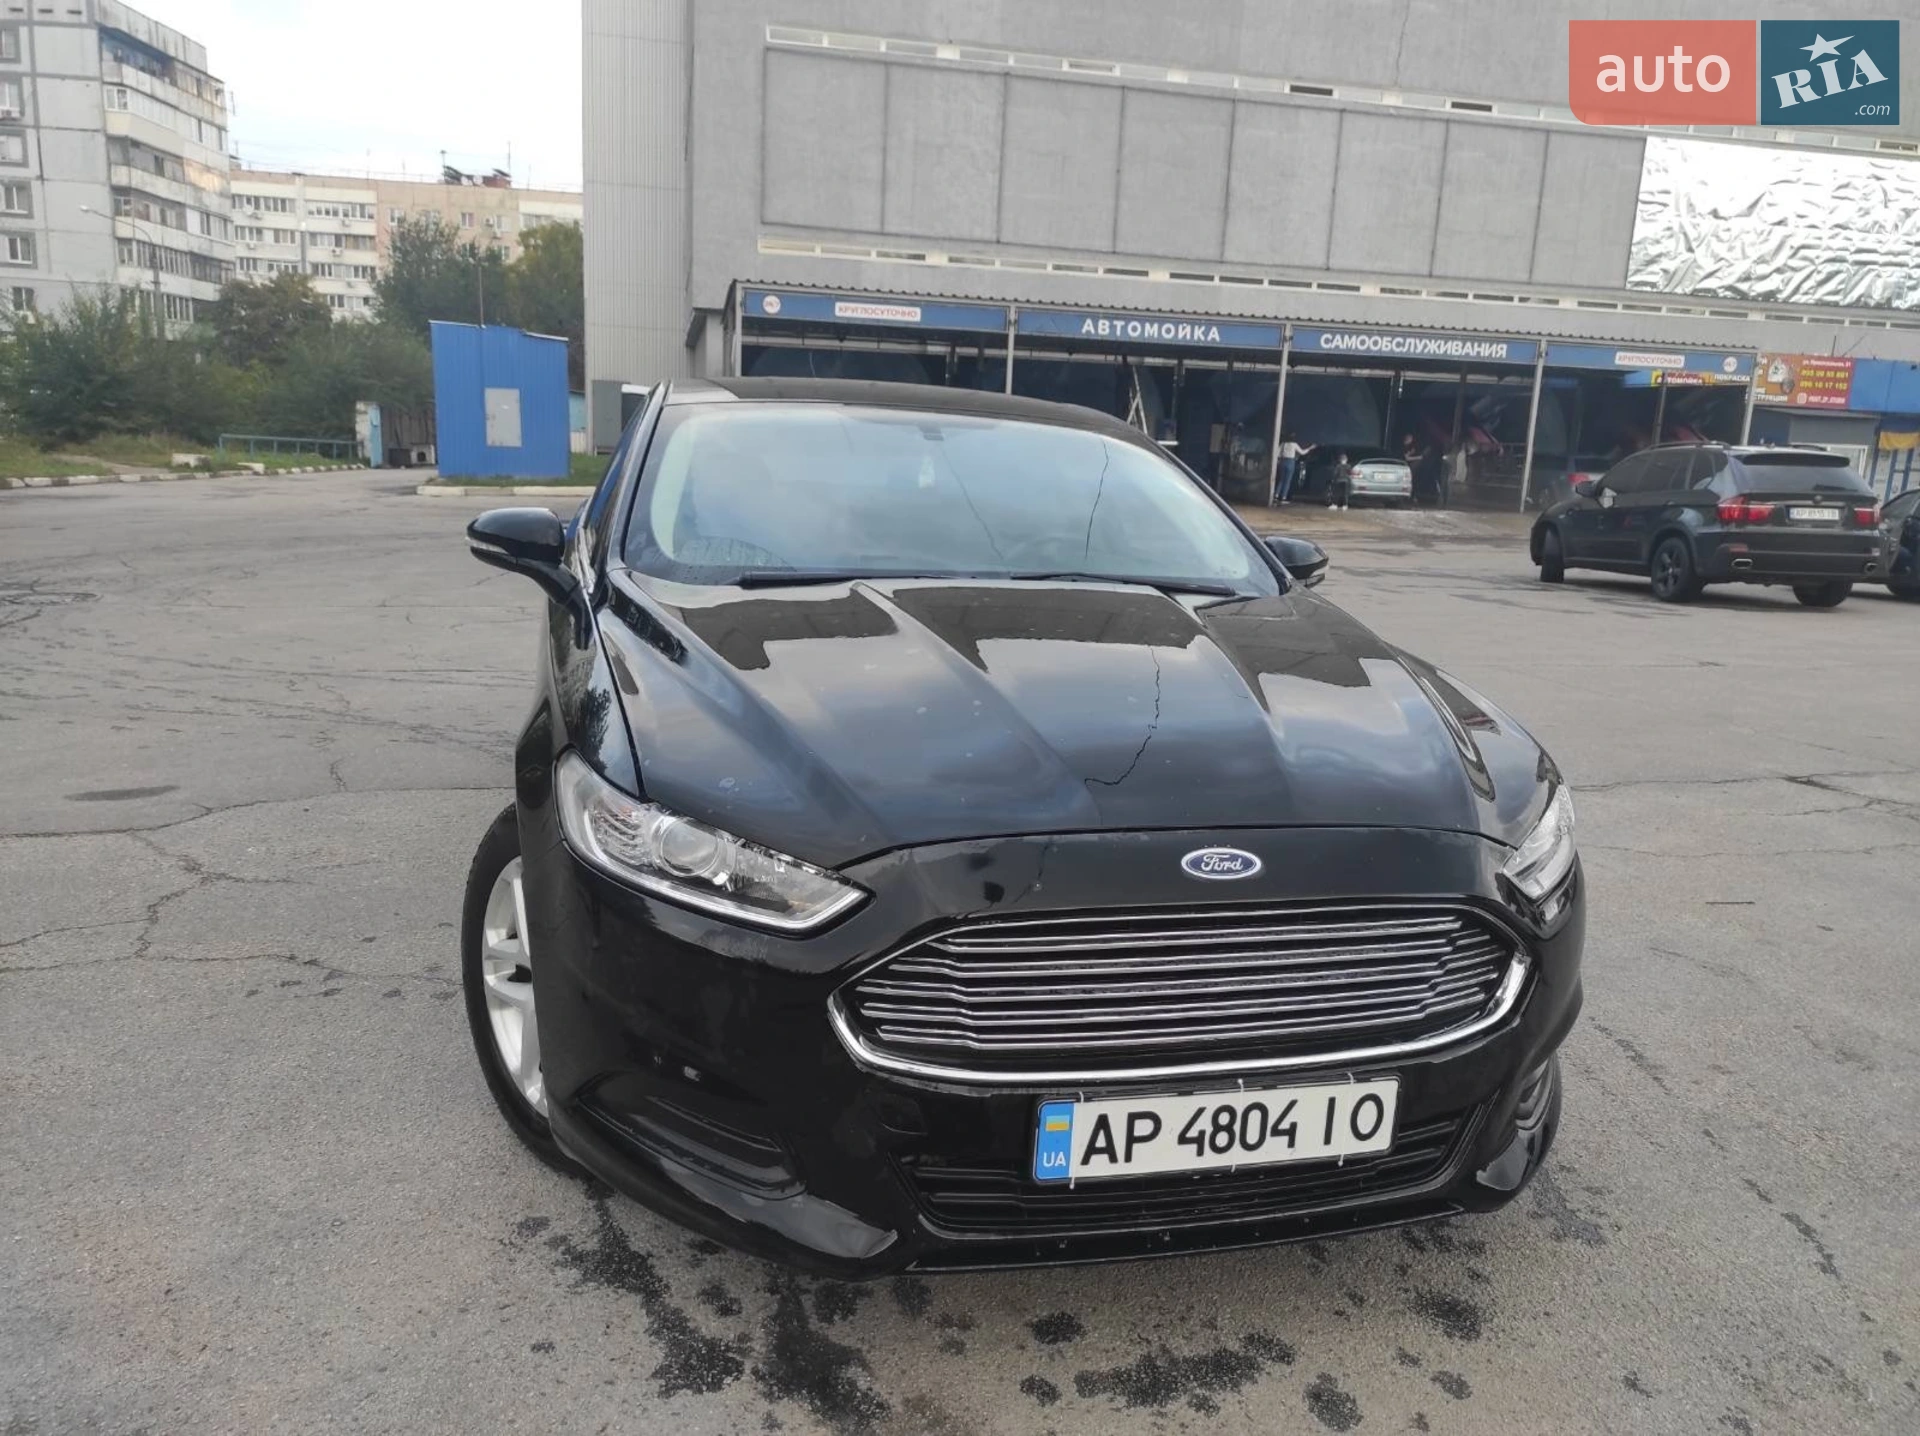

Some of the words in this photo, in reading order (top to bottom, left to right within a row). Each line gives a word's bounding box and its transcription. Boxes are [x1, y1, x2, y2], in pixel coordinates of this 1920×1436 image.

[838, 305, 918, 319] КРУГЛОСУТОЧНО
[1081, 318, 1221, 342] АВТОМОЙКА
[1320, 333, 1507, 358] САМООБСЛУЖИВАНИЯ
[1201, 854, 1243, 871] Ford
[1080, 1110, 1162, 1165] AP
[1177, 1099, 1298, 1157] 4804
[1323, 1093, 1384, 1146] IO
[1043, 1151, 1067, 1168] UA
